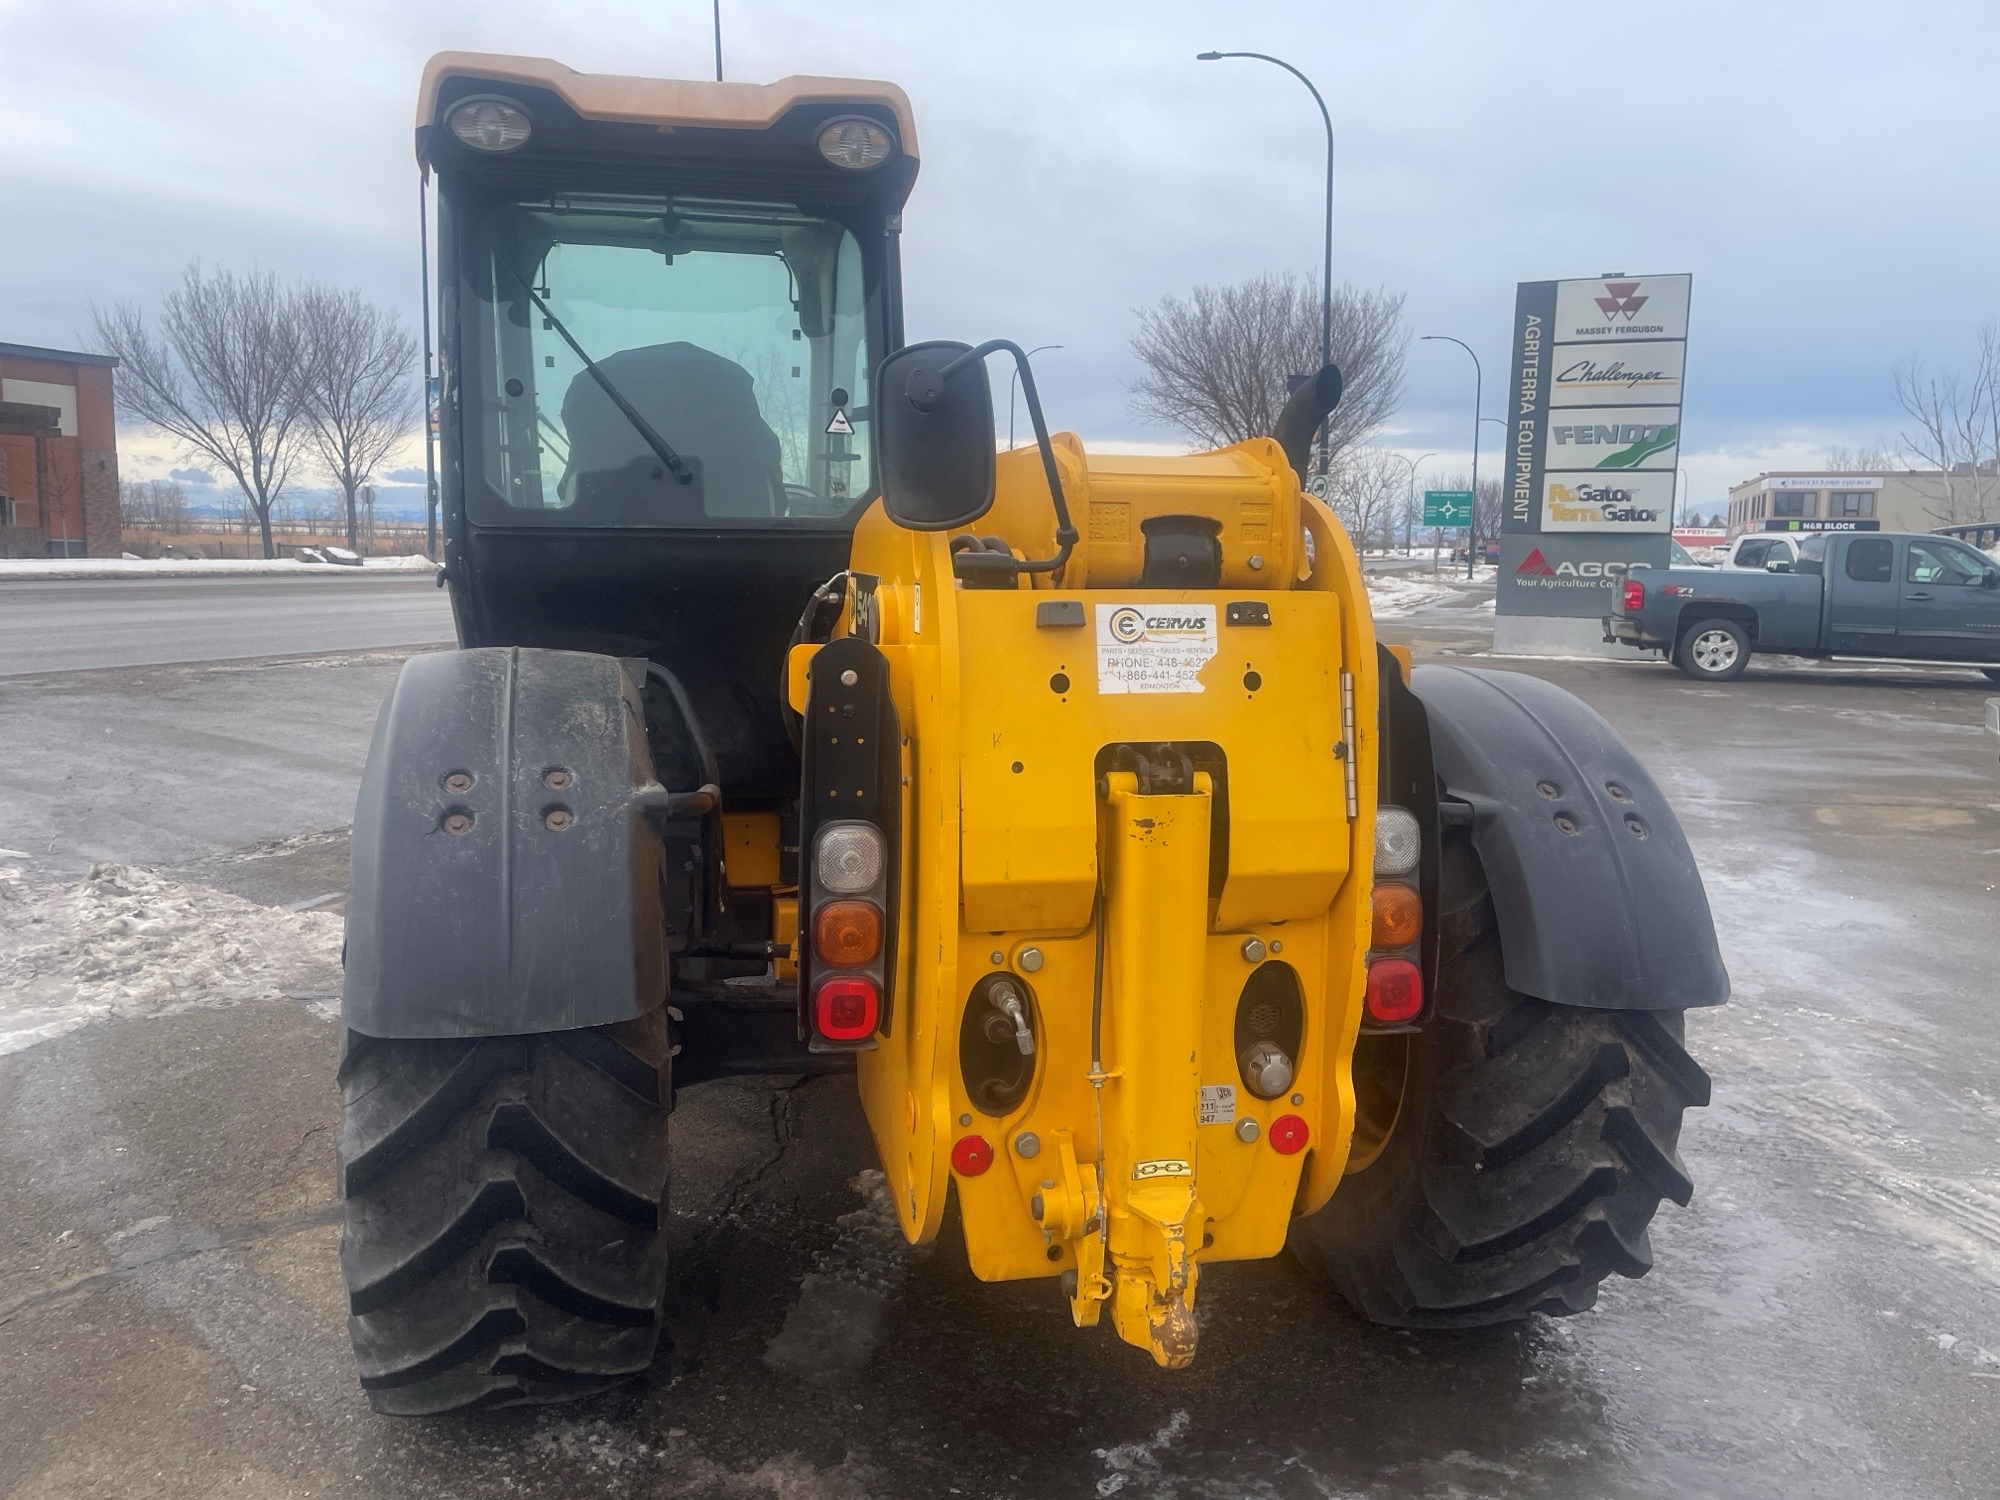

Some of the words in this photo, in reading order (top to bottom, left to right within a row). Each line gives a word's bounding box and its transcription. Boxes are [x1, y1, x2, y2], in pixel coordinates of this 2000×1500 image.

[1575, 326, 1613, 336] MASSEY
[1615, 324, 1664, 335] FERGUSON
[1519, 314, 1542, 415] AGRITERRA
[1555, 359, 1679, 389] Challenger
[1552, 424, 1671, 445] FENDT
[1513, 419, 1536, 523] EQUIPMENT
[1549, 483, 1637, 503] RoGator
[1548, 503, 1662, 522] TerraGator
[1802, 522, 1823, 530] H&R
[1823, 522, 1856, 530] BLOCK
[1516, 578, 1537, 587] Your
[1541, 578, 1596, 589] Agriculture
[1145, 617, 1206, 630] CERVUS
